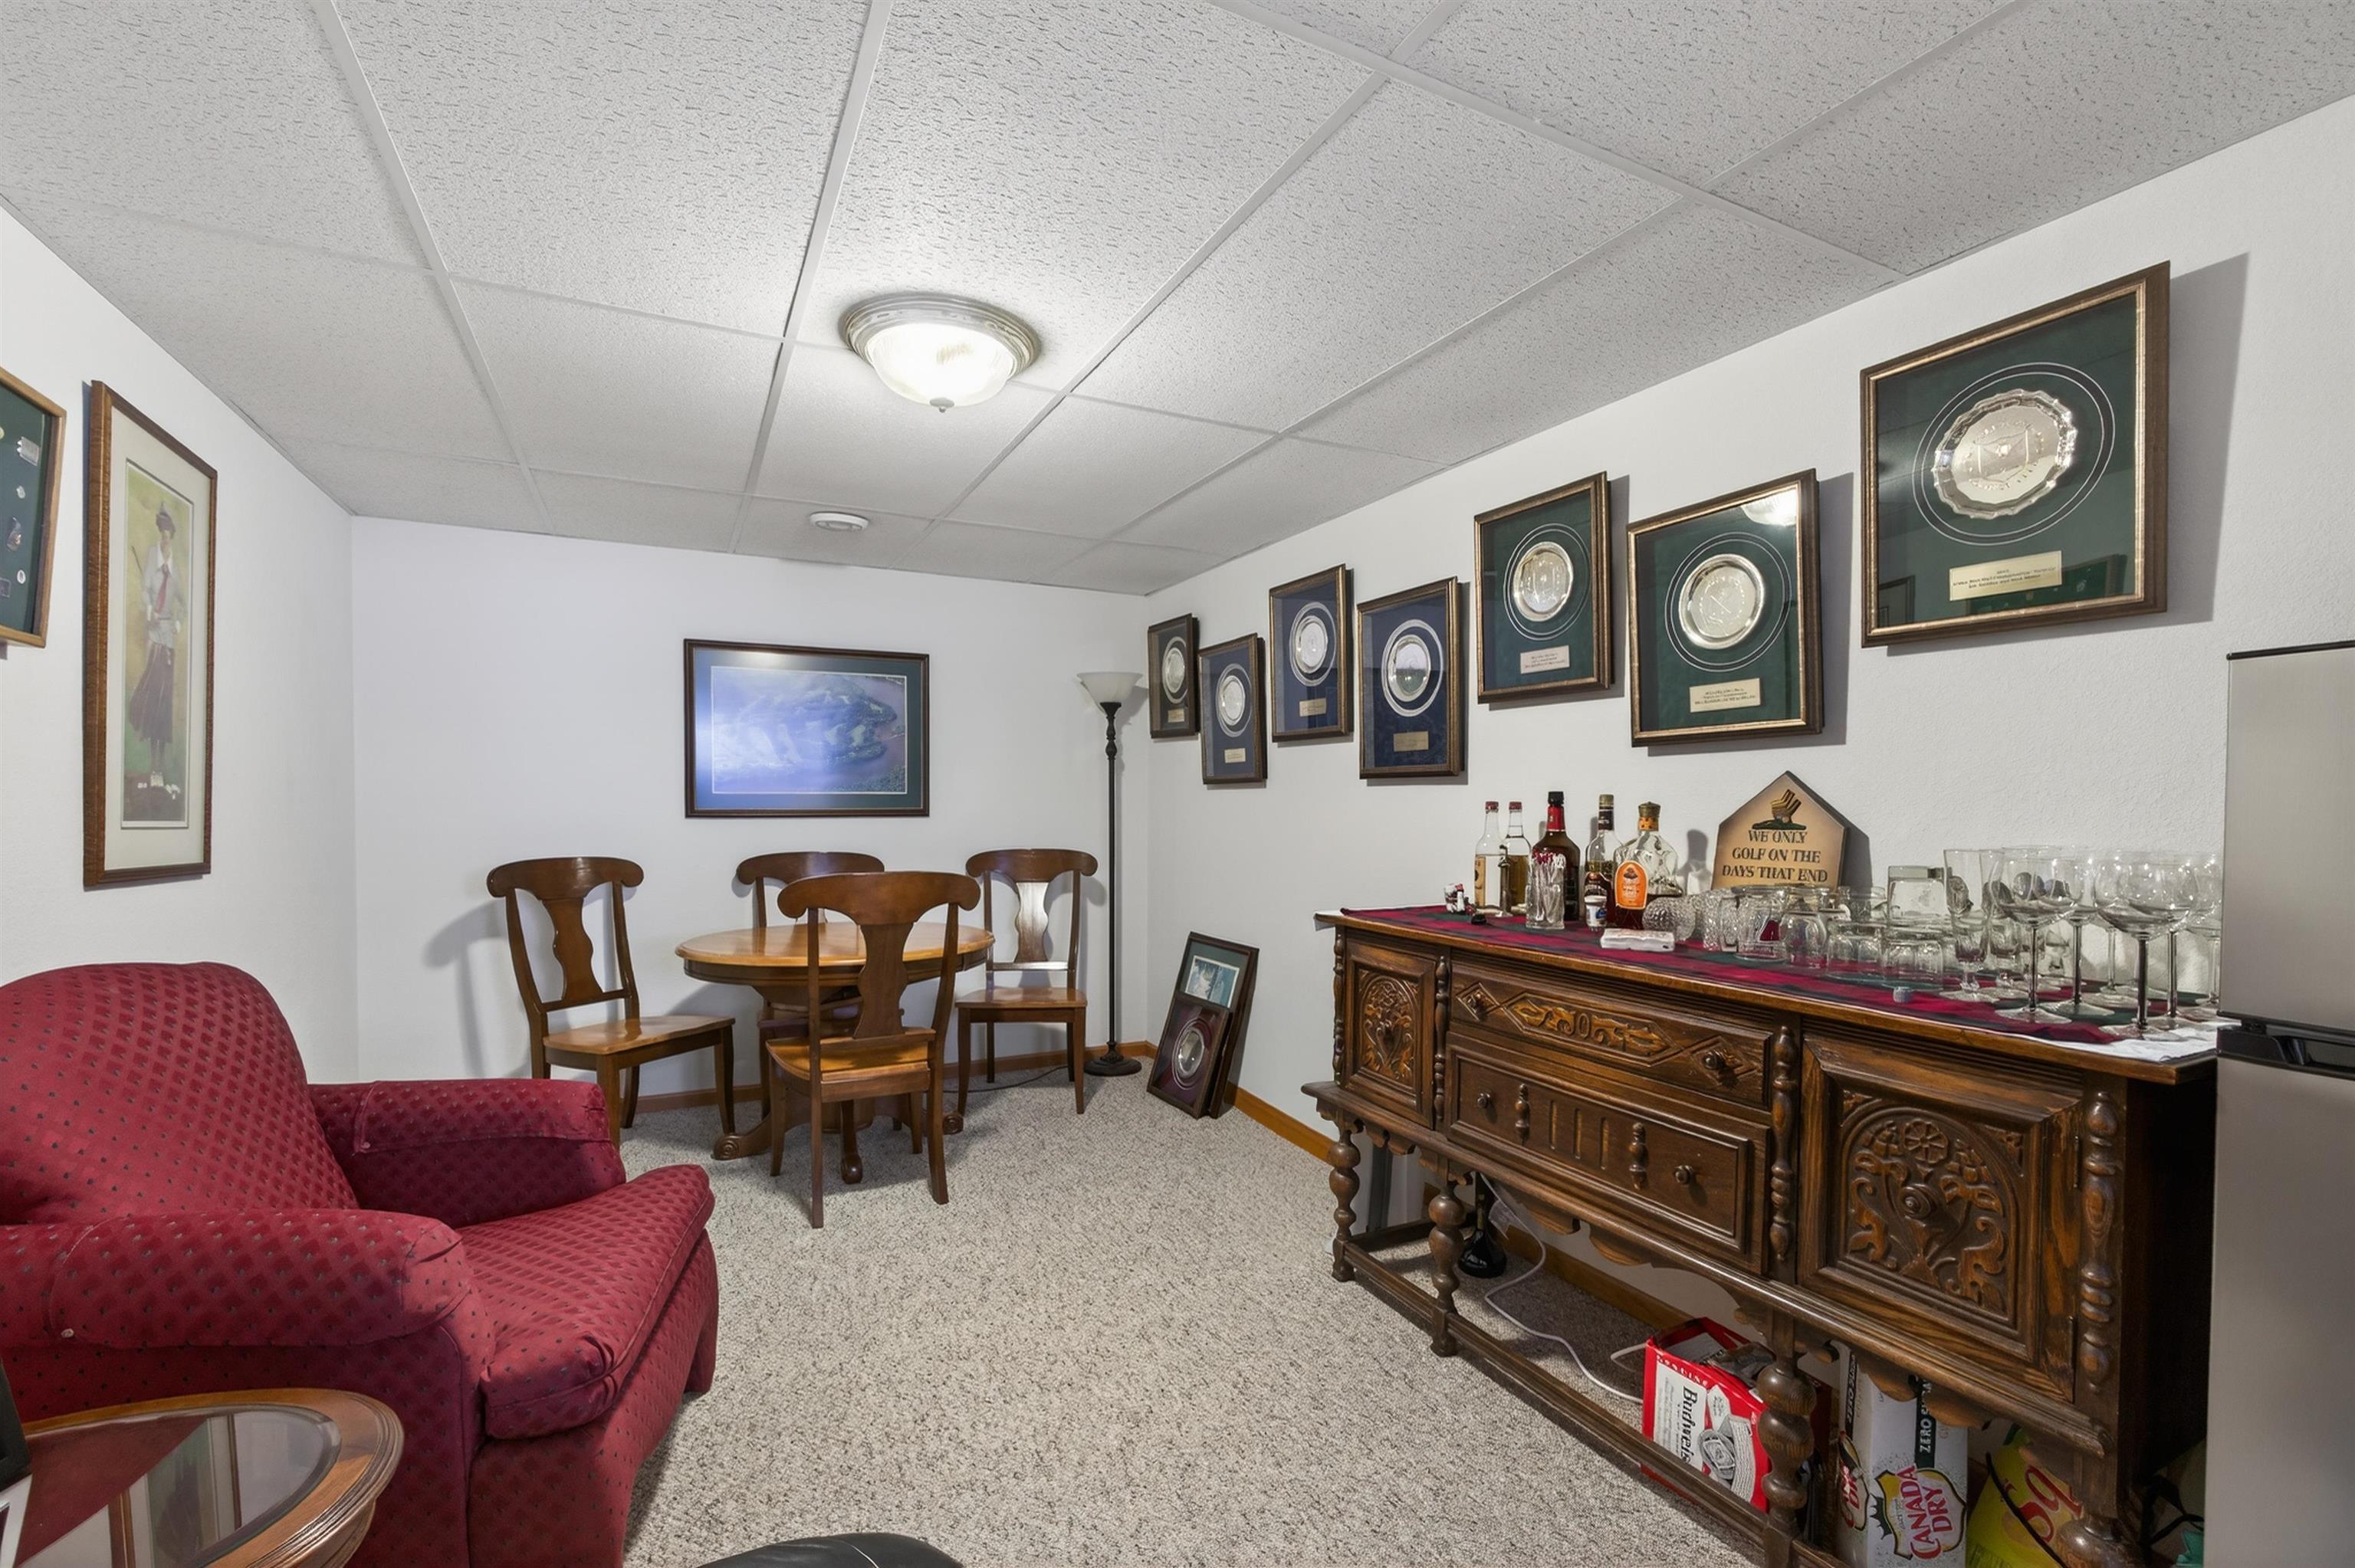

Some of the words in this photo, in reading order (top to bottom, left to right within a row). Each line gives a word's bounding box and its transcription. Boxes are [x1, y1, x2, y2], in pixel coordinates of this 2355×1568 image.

[1748, 830, 1769, 843] WE
[1772, 831, 1808, 844] ONLY
[1732, 847, 1766, 860] GOLF
[1769, 849, 1789, 861] ON
[1792, 850, 1821, 863] THE
[1722, 864, 1755, 877] DAYS
[1757, 866, 1795, 881] THAT
[1798, 868, 1828, 882] END
[1920, 1419, 1933, 1453] ZERO
[1896, 1465, 1942, 1560] CANADA
[1922, 1486, 1953, 1533] DRY
